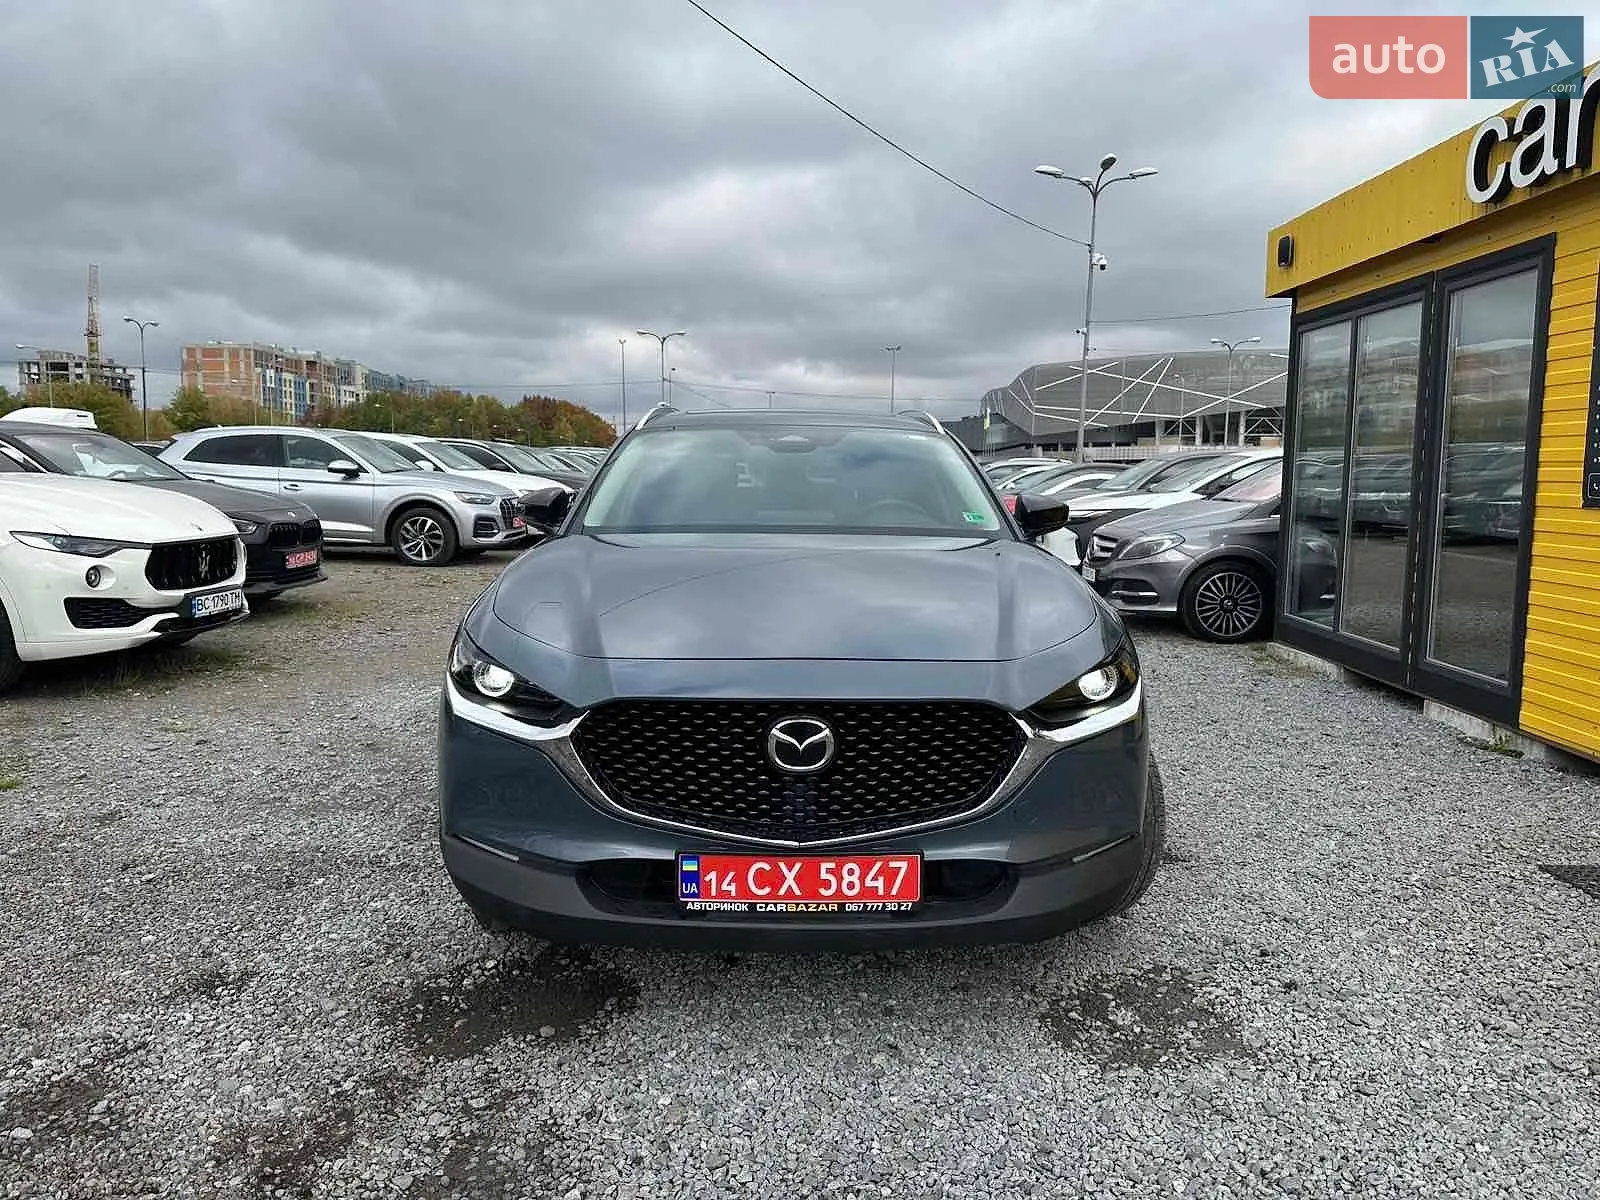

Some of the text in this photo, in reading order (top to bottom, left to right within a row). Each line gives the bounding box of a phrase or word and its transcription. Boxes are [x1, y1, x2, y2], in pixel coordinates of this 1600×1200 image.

[682, 861, 909, 897] UA 14 CX 5847
[686, 902, 913, 912] АВТОРИНОК CARBAZAR 067 777 30 27
